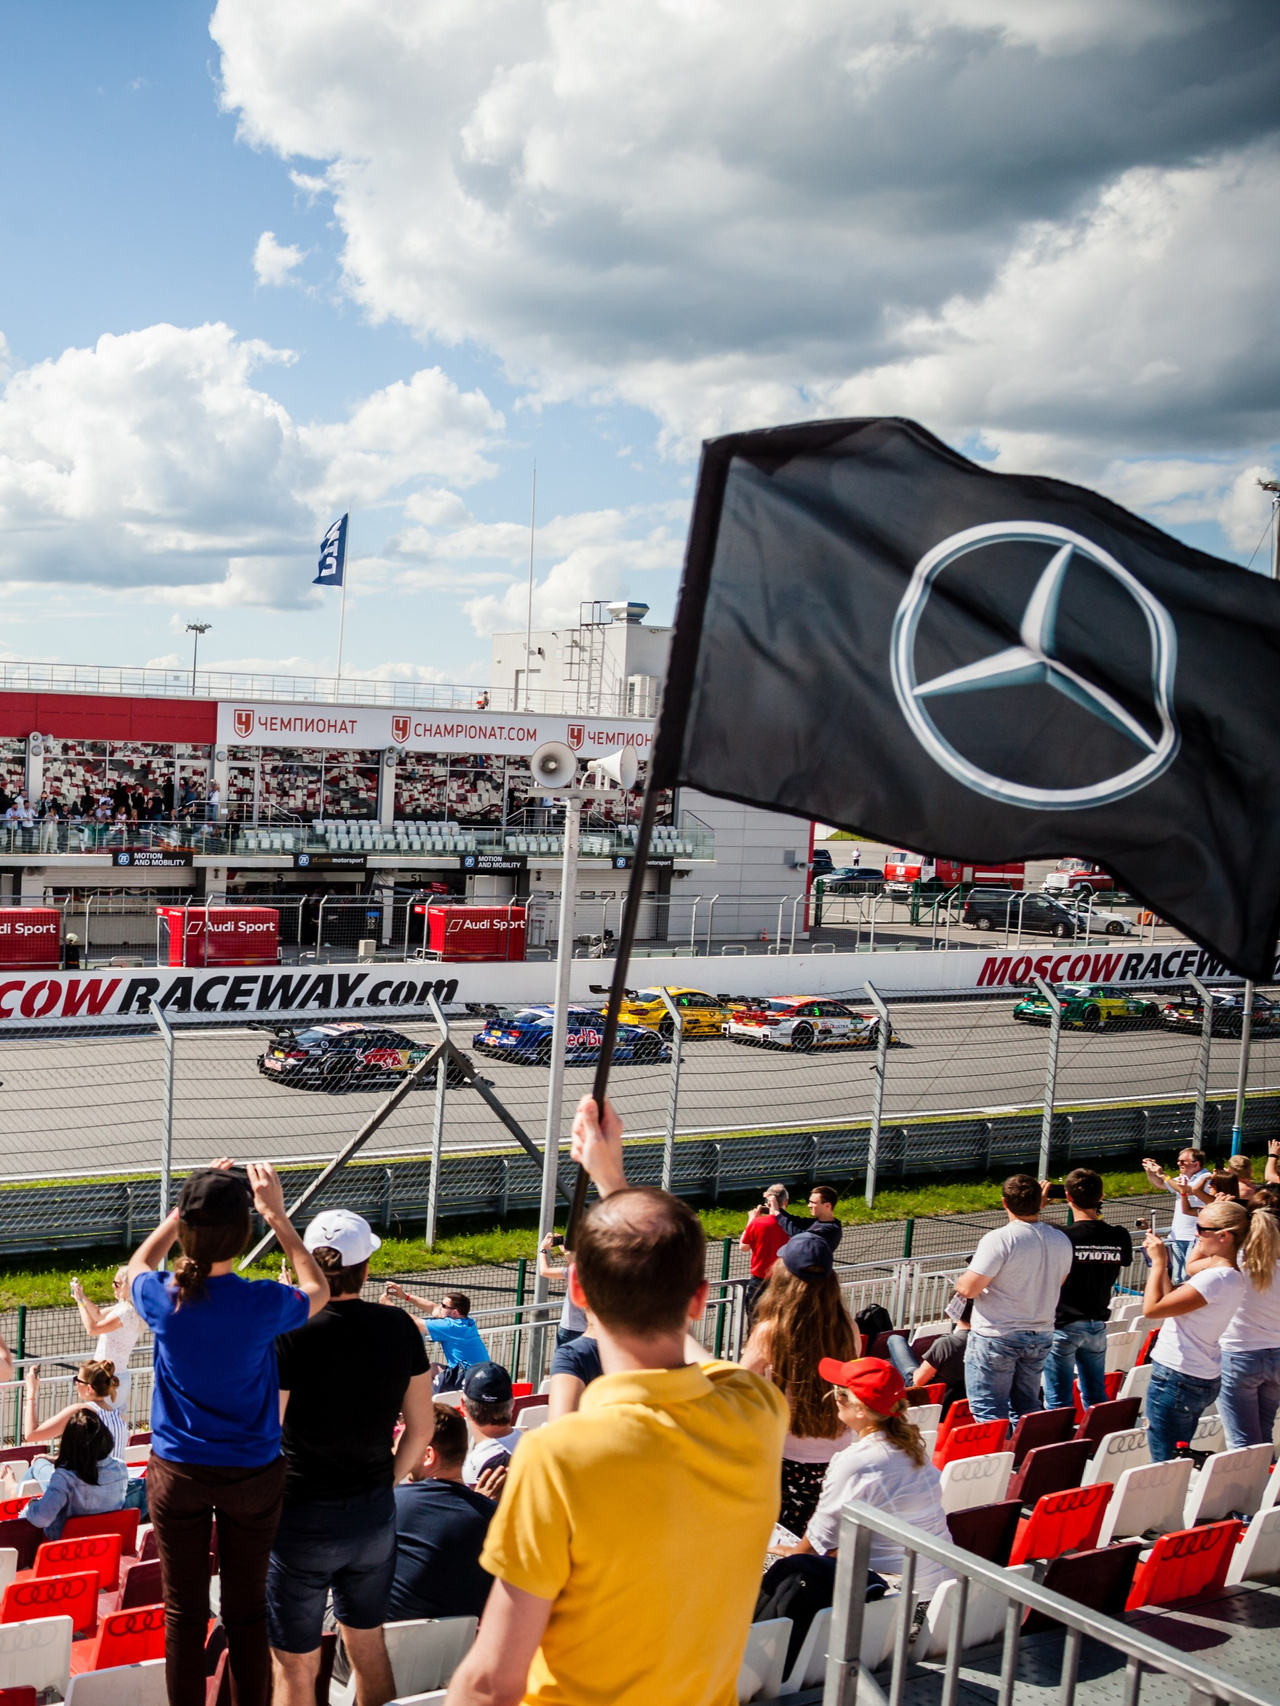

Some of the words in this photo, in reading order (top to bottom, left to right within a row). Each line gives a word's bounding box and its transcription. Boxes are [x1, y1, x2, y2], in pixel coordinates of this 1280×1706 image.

[258, 717, 357, 734] ЧЕМПИОНАТ
[414, 723, 537, 741] CHAMPIONAT.COM
[588, 731, 654, 746] ЧЕМПИОН
[14, 923, 56, 936] Sport
[204, 922, 234, 932] Audi
[238, 921, 275, 934] Sport
[463, 919, 490, 929] Audi
[493, 919, 525, 931] Sport
[566, 1029, 586, 1047] ed
[1074, 1252, 1120, 1261] ЧУКОТКА
